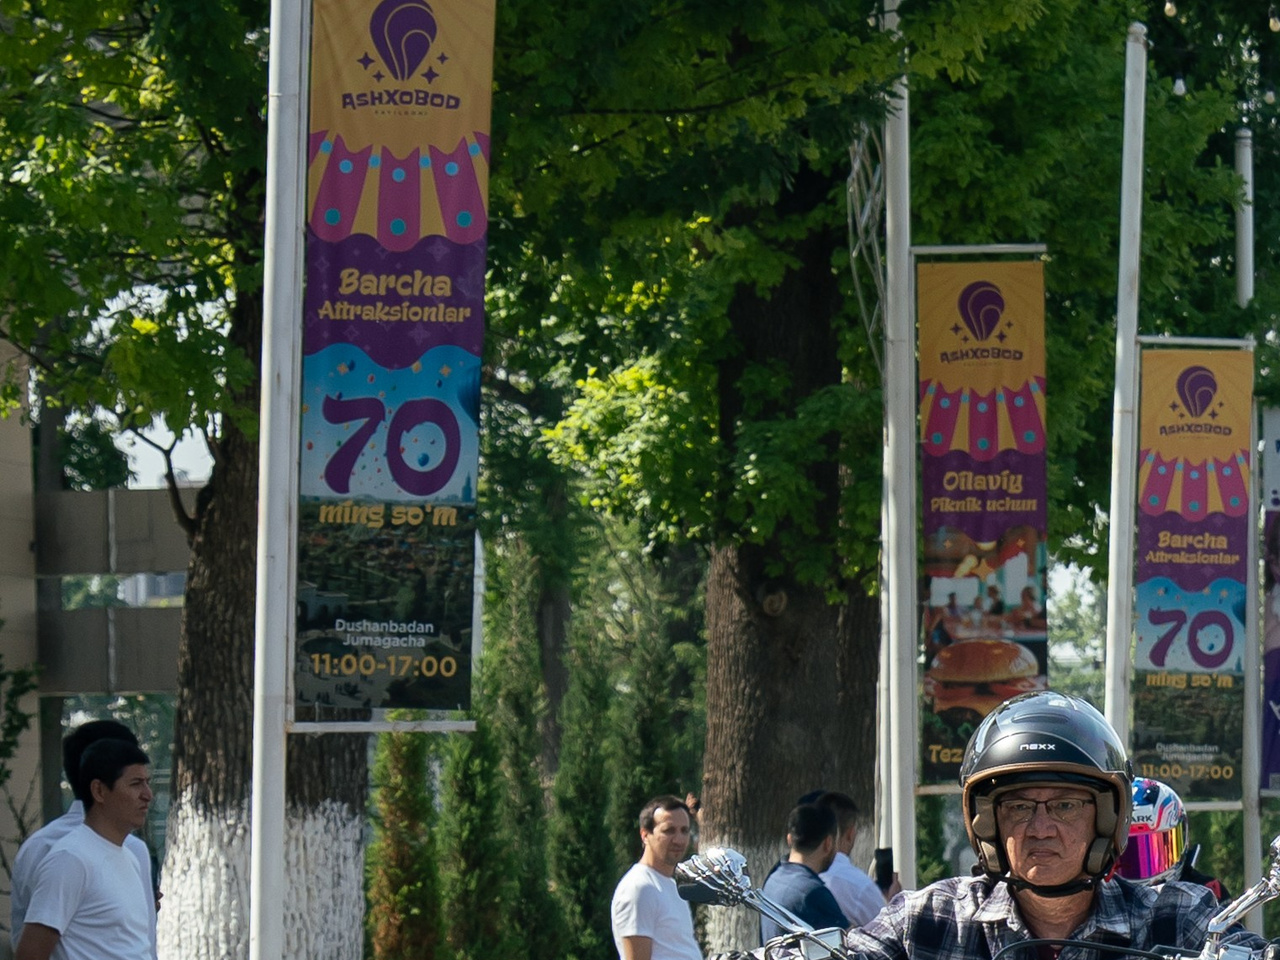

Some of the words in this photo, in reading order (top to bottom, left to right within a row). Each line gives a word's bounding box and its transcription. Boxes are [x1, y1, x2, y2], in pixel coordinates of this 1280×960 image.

[341, 89, 461, 110] ASHXOBOD
[338, 268, 452, 297] Barcha
[318, 300, 472, 323] Attraksionlar
[939, 347, 1024, 364] ASHXOBOD
[1159, 423, 1232, 436] ASHXOBOD
[322, 394, 461, 497] 70
[931, 497, 982, 512] Piknik
[986, 497, 1037, 512] uchun
[319, 501, 385, 528] ming
[391, 503, 458, 527] so'm
[1158, 530, 1228, 549] Barcha
[1145, 550, 1240, 565] Attraksionlar
[335, 619, 434, 634] Dushanbadan
[342, 633, 426, 649] Jumagacha
[1148, 606, 1234, 669] 70
[310, 653, 458, 678] 11:00-17:00
[1146, 672, 1187, 689] ming
[928, 744, 963, 764] Tez
[1142, 764, 1234, 779] 11:00-17:00
